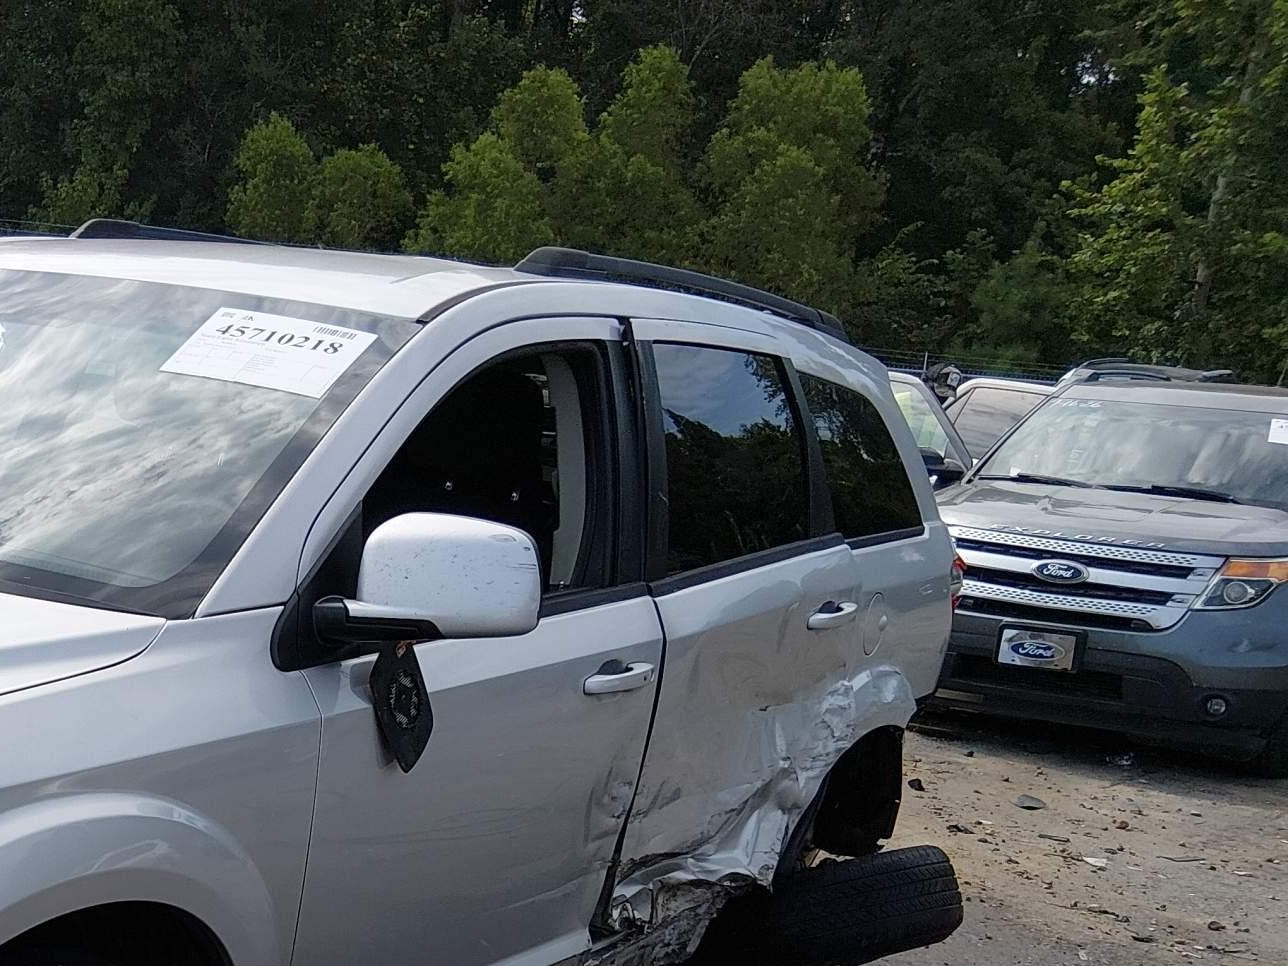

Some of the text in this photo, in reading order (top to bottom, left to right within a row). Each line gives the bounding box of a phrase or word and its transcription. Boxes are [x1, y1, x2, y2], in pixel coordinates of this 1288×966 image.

[216, 324, 343, 354] 45710218
[1043, 562, 1073, 578] Ford
[1018, 641, 1055, 657] Ford
